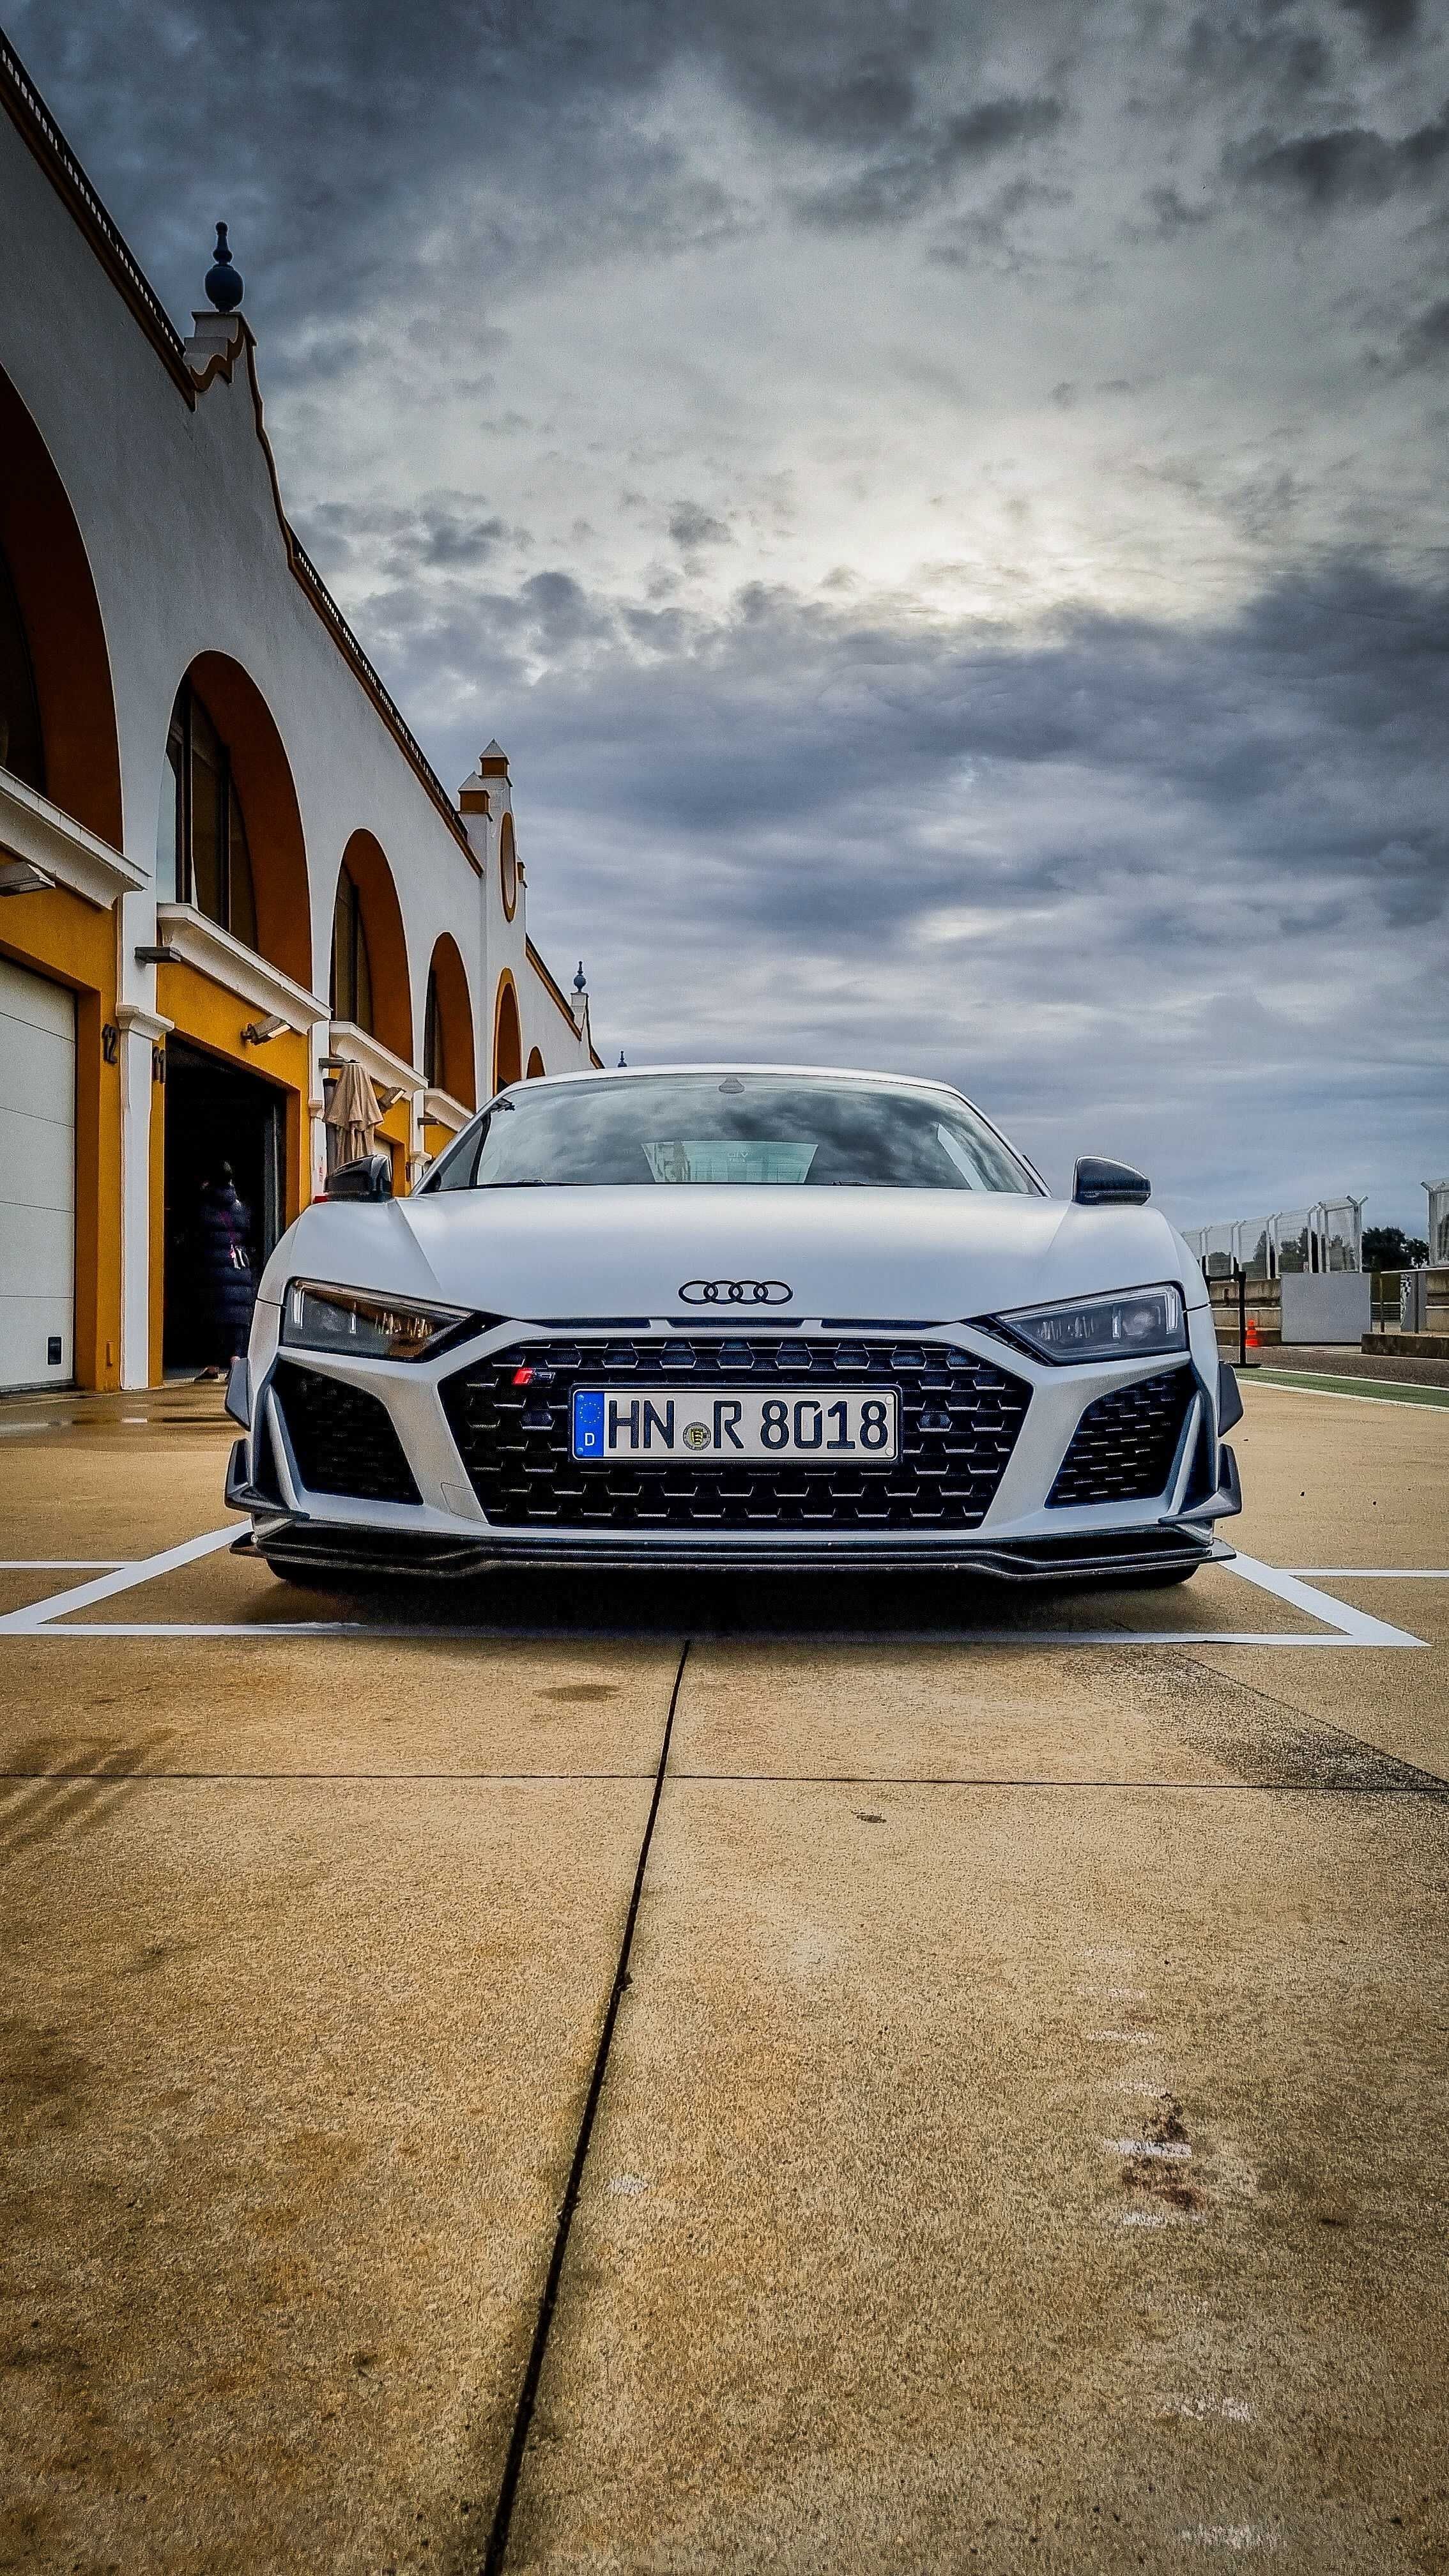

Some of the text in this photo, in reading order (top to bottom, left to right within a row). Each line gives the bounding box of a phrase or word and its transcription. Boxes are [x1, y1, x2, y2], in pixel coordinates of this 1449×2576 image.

[102, 1023, 119, 1064] 12
[584, 1432, 595, 1446] D
[608, 1399, 889, 1450] HN R 8018
